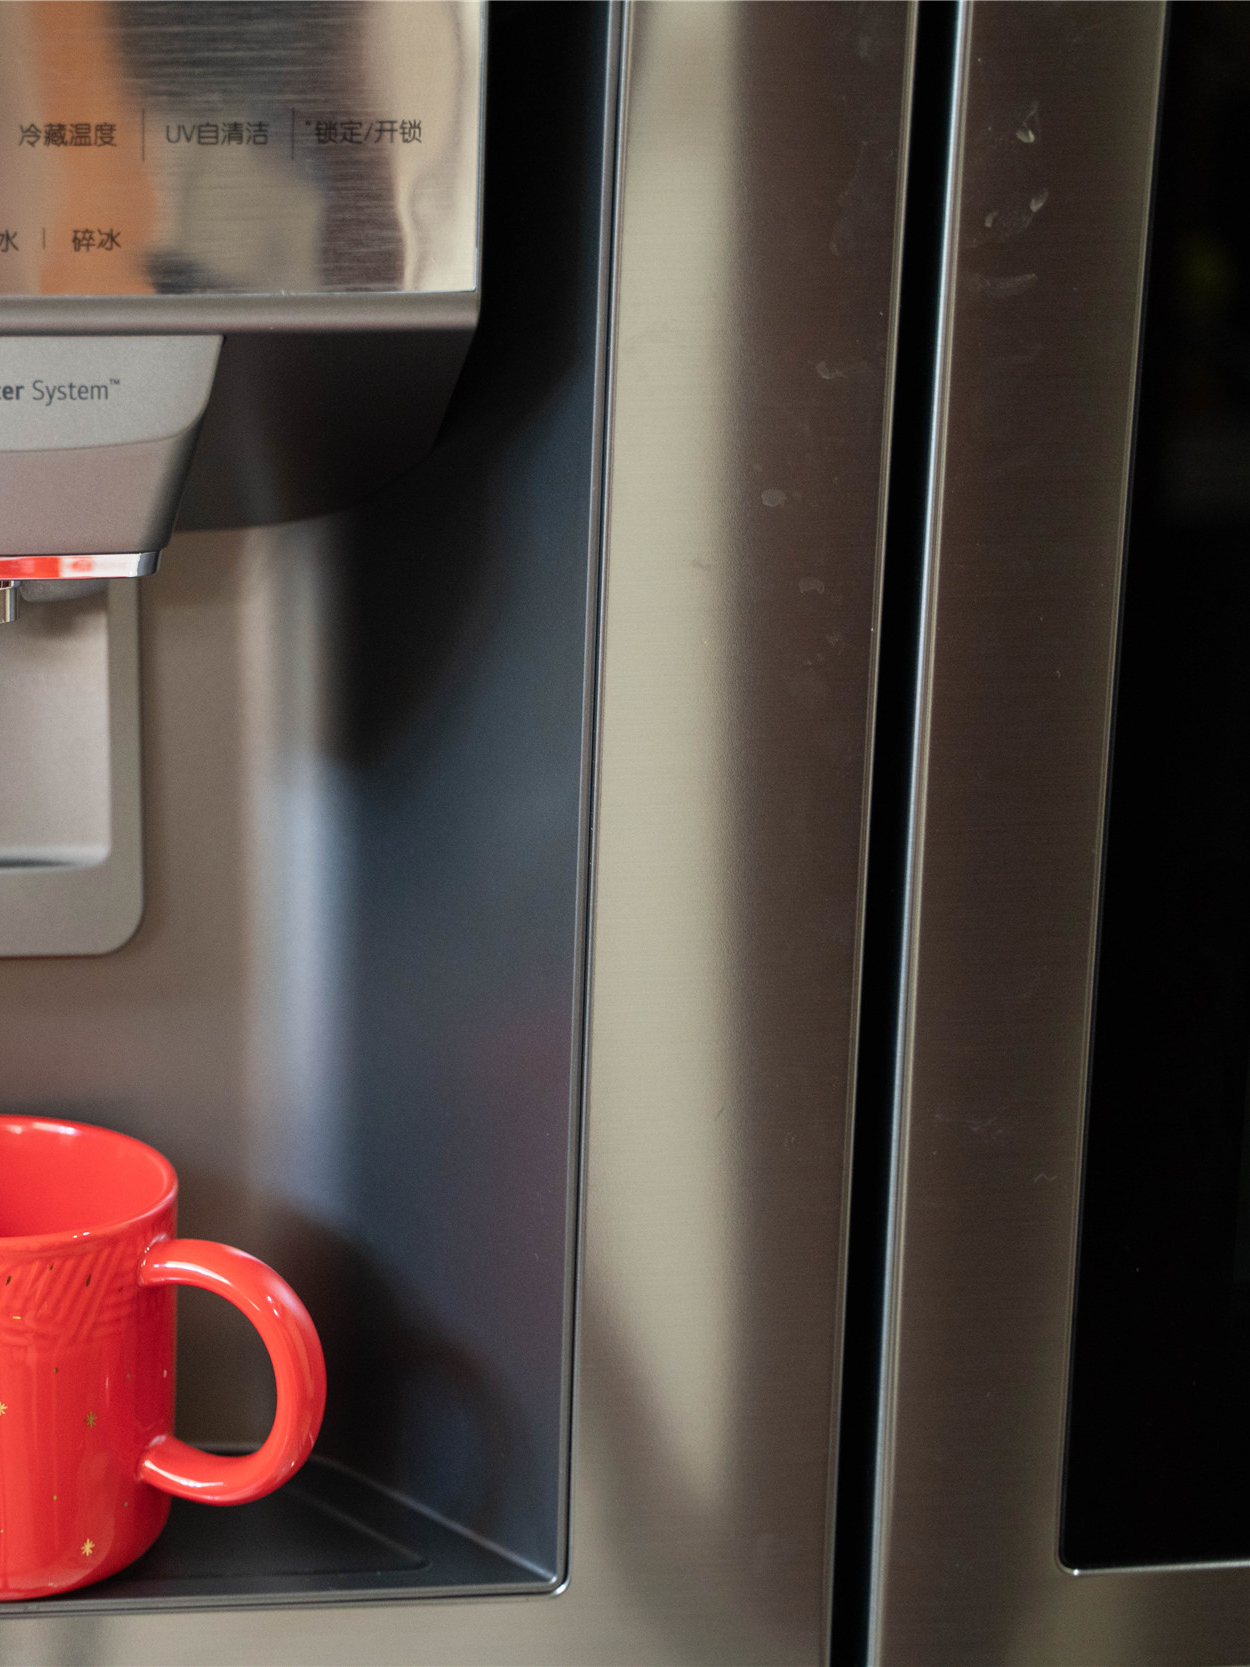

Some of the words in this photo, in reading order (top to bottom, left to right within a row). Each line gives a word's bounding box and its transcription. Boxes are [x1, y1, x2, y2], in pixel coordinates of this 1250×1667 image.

[19, 122, 118, 148] 冷藏温度
[166, 122, 270, 147] UV自清洁
[71, 228, 122, 253] 碎冰
